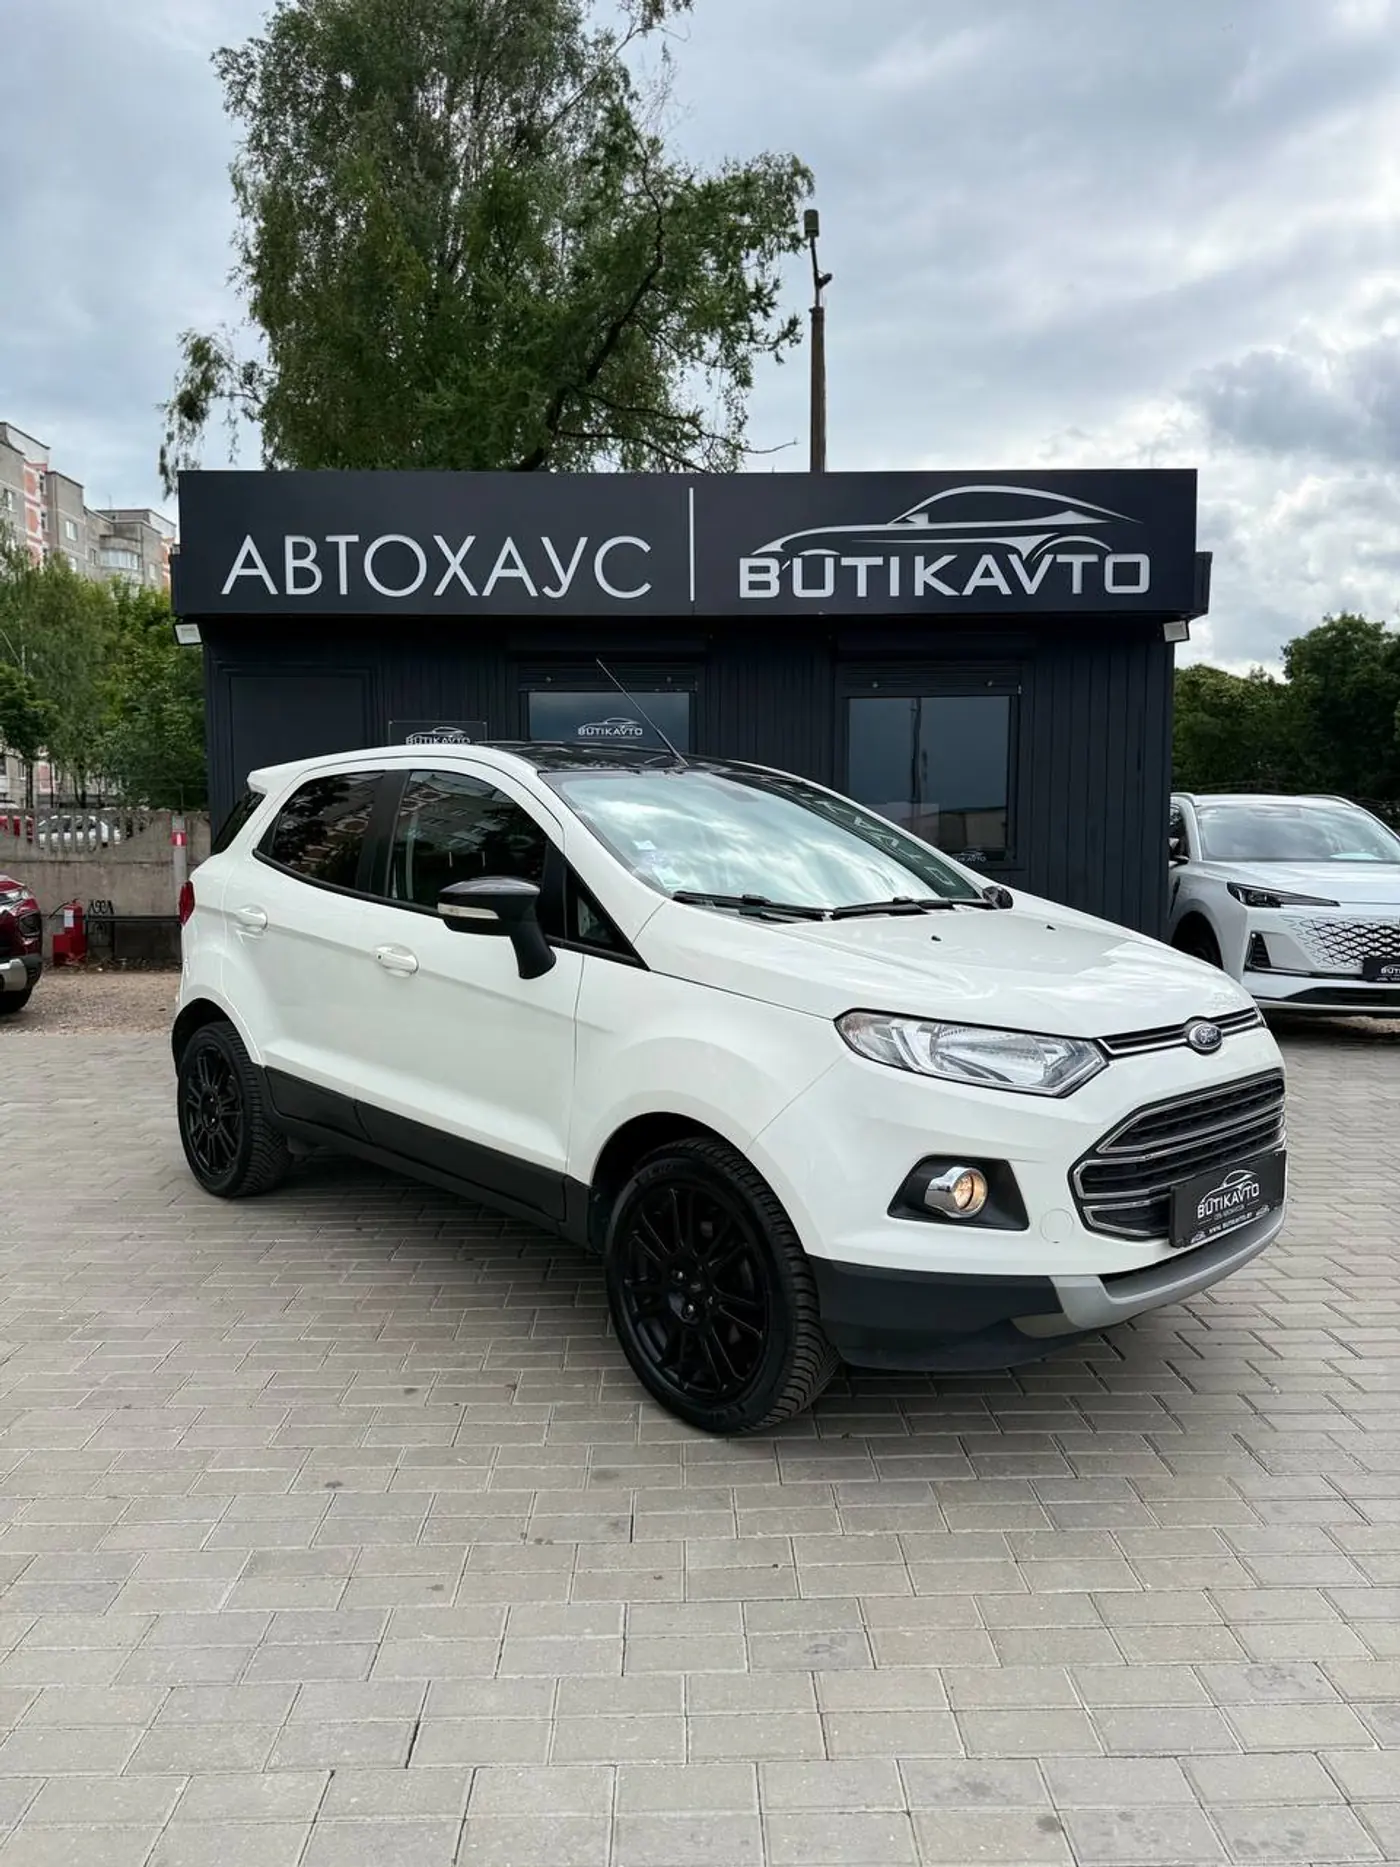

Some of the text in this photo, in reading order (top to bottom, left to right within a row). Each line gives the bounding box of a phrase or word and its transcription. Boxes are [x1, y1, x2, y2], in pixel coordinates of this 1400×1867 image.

[221, 534, 653, 600] АВТОХАУС
[739, 552, 1151, 599] BUTIKAVTO
[577, 727, 643, 736] BUTIKAVTO
[1197, 1183, 1260, 1219] BUTIKAVTO
